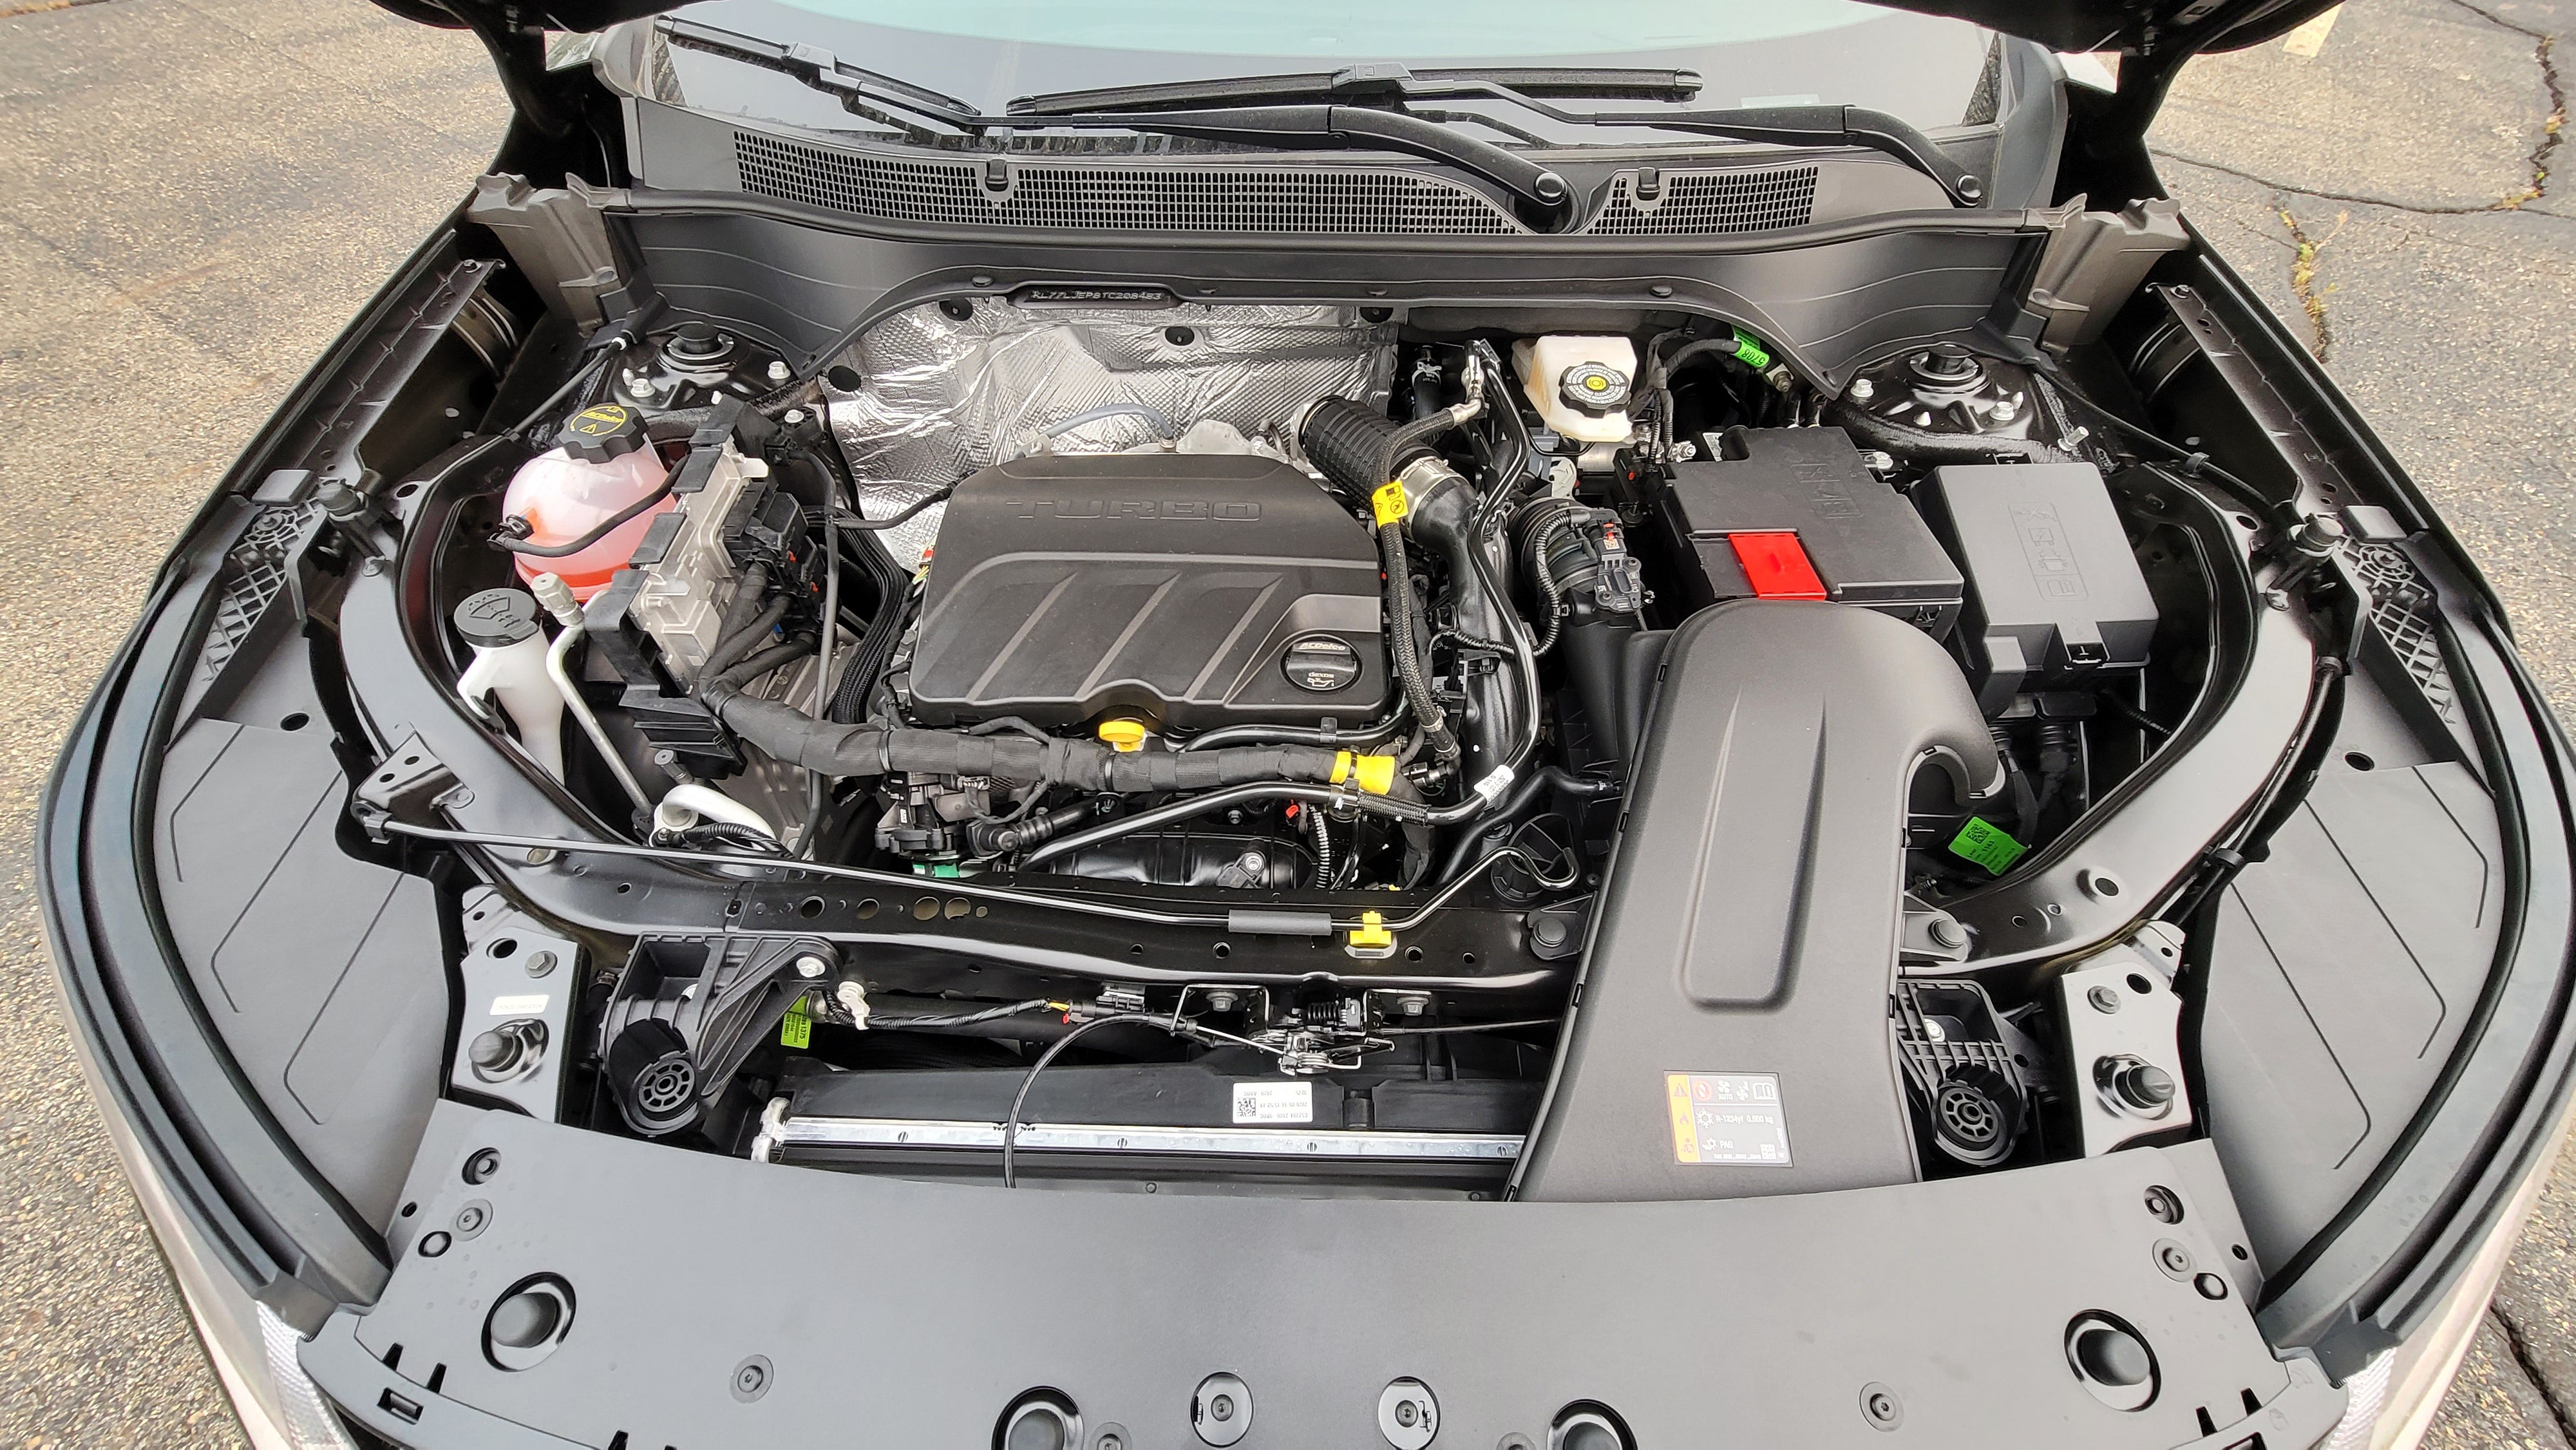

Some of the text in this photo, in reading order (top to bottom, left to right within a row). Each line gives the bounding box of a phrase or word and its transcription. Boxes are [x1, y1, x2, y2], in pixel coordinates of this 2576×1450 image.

[1030, 289, 1162, 301] KL77LJEP8TC208483
[1741, 348, 1766, 366] 5708
[1006, 500, 1262, 522] TURBO
[1298, 643, 1346, 651] ACDelco
[1715, 1115, 1743, 1124] R-1234yf
[1765, 1115, 1774, 1124] kg
